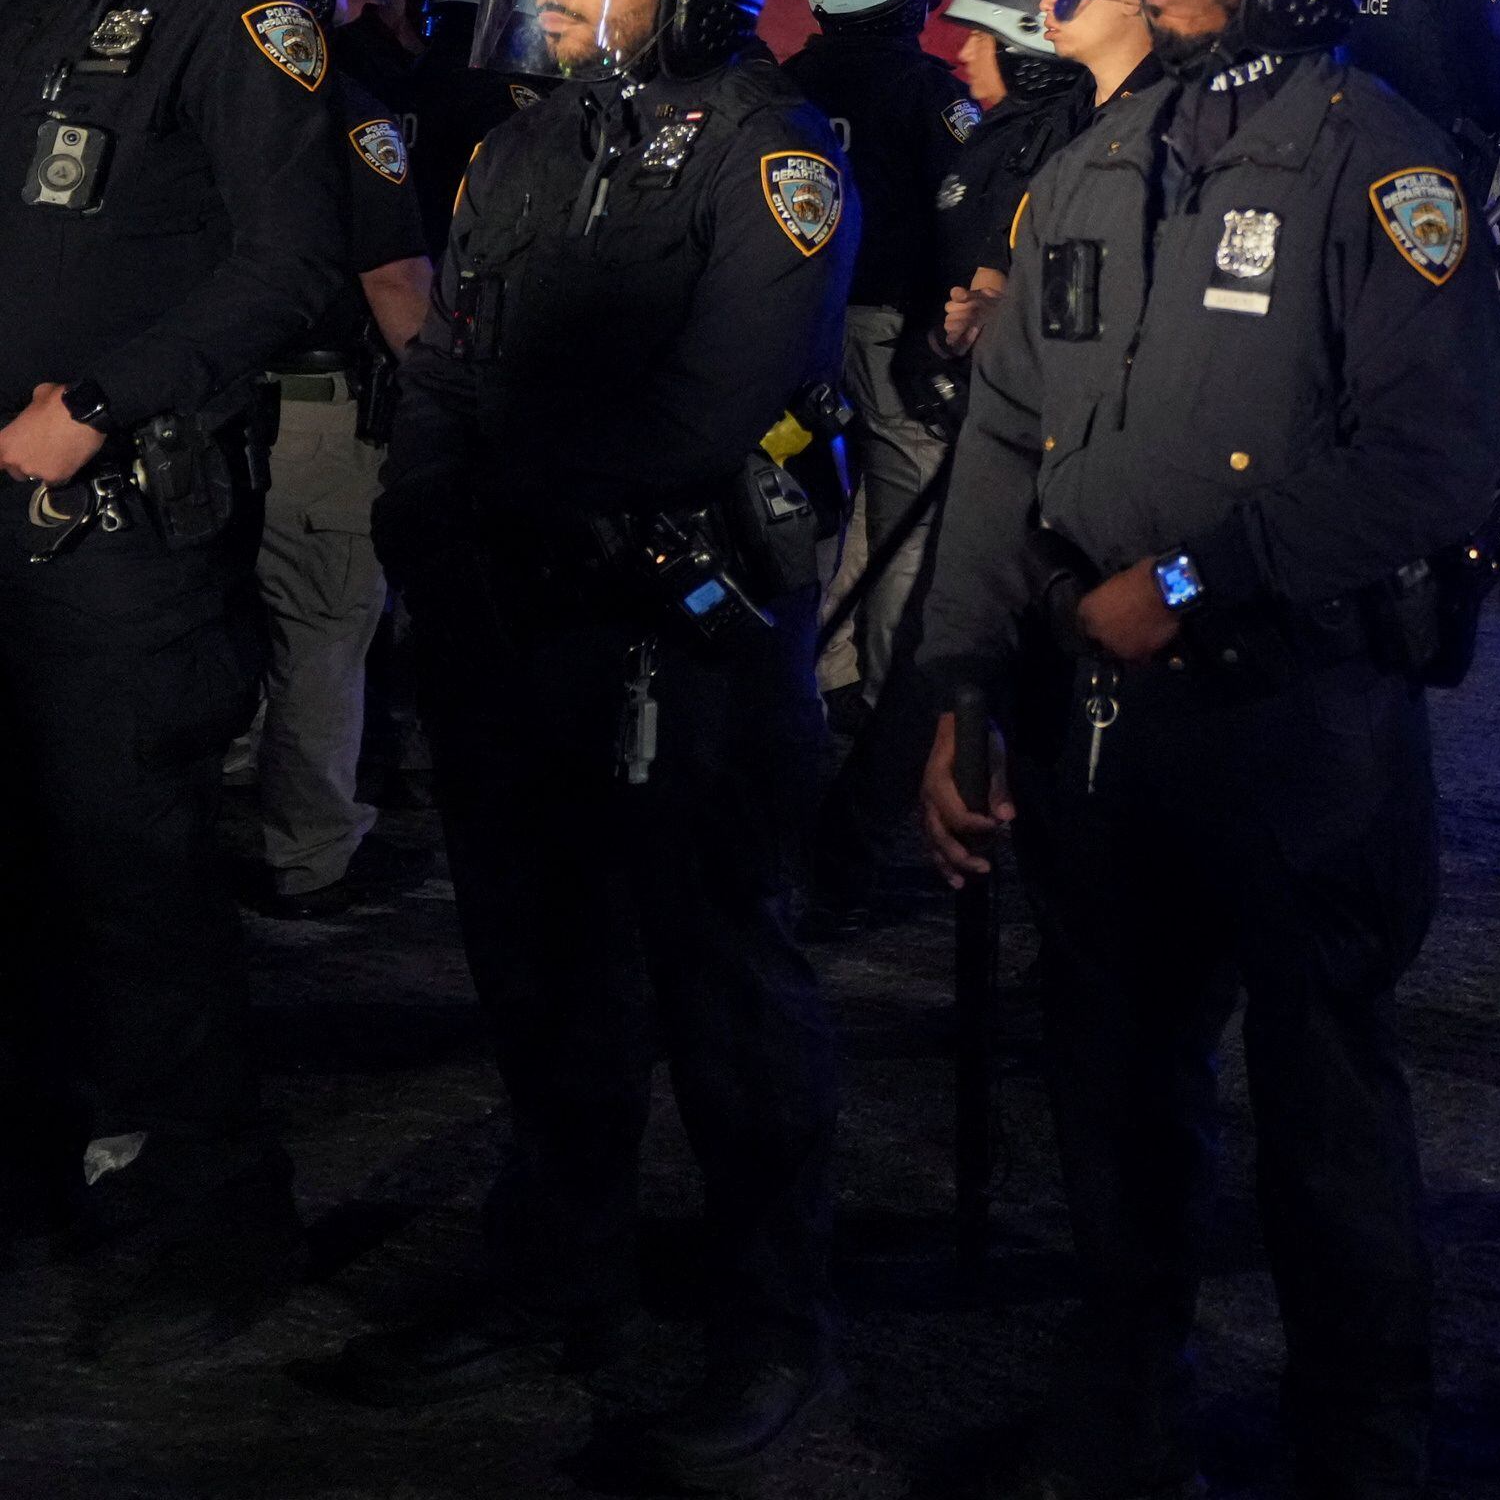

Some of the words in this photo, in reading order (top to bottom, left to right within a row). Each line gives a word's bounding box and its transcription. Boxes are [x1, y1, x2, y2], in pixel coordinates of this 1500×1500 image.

[265, 7, 302, 19] POLICE
[264, 43, 287, 63] CITY
[286, 62, 301, 75] OF
[787, 157, 827, 173] POLICE
[772, 170, 837, 191] DEPARTMENT
[772, 193, 791, 220] CITY
[787, 218, 802, 237] OF
